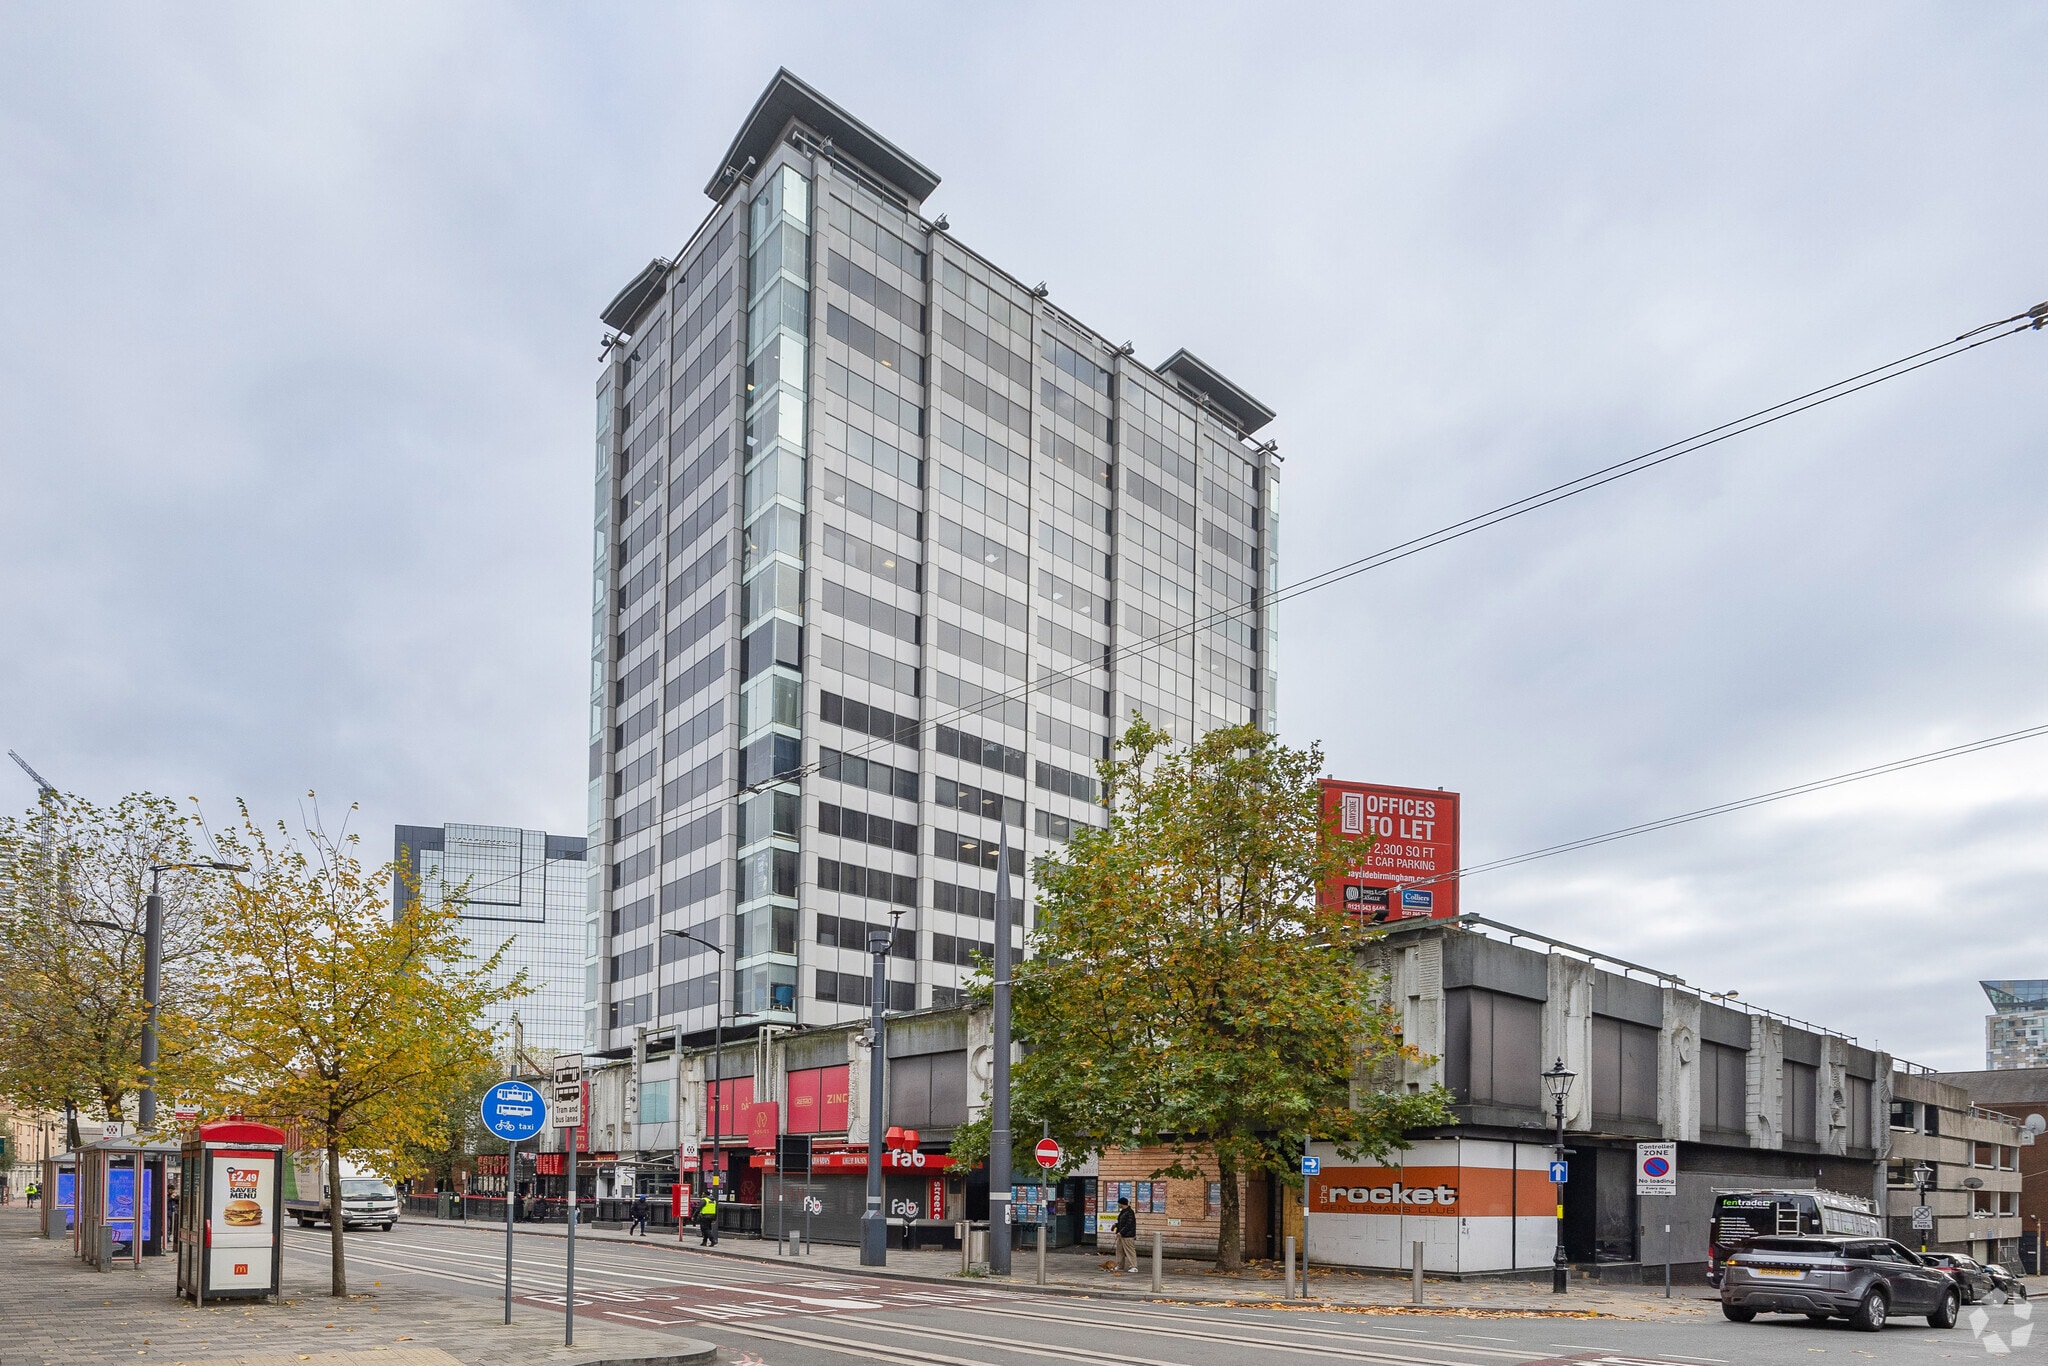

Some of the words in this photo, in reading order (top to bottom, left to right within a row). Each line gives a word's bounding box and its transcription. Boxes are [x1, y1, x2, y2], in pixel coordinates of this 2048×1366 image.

[1366, 795, 1435, 818] OFFICES
[1366, 815, 1393, 837] TO
[1400, 818, 1435, 841] LET
[1374, 843, 1403, 856] 2,300
[1405, 845, 1420, 858] SQ
[1422, 847, 1435, 859] FT
[1375, 856, 1394, 867] CAR
[1396, 859, 1435, 871] PARKING
[1405, 893, 1430, 901] Colliers
[826, 1093, 848, 1104] ZINC
[569, 1104, 578, 1112] and
[536, 1153, 561, 1175] UGLY
[892, 1148, 926, 1167] fab
[230, 1170, 257, 1182] £2.49
[933, 1181, 942, 1212] street
[1320, 1185, 1328, 1204] the
[1329, 1183, 1456, 1205] rocket
[891, 1199, 918, 1215] fab
[1321, 1204, 1411, 1214] GENTLEMANS
[1418, 1205, 1456, 1214] CLUB
[523, 1289, 680, 1307] BUS
[602, 1300, 838, 1325] LANE
